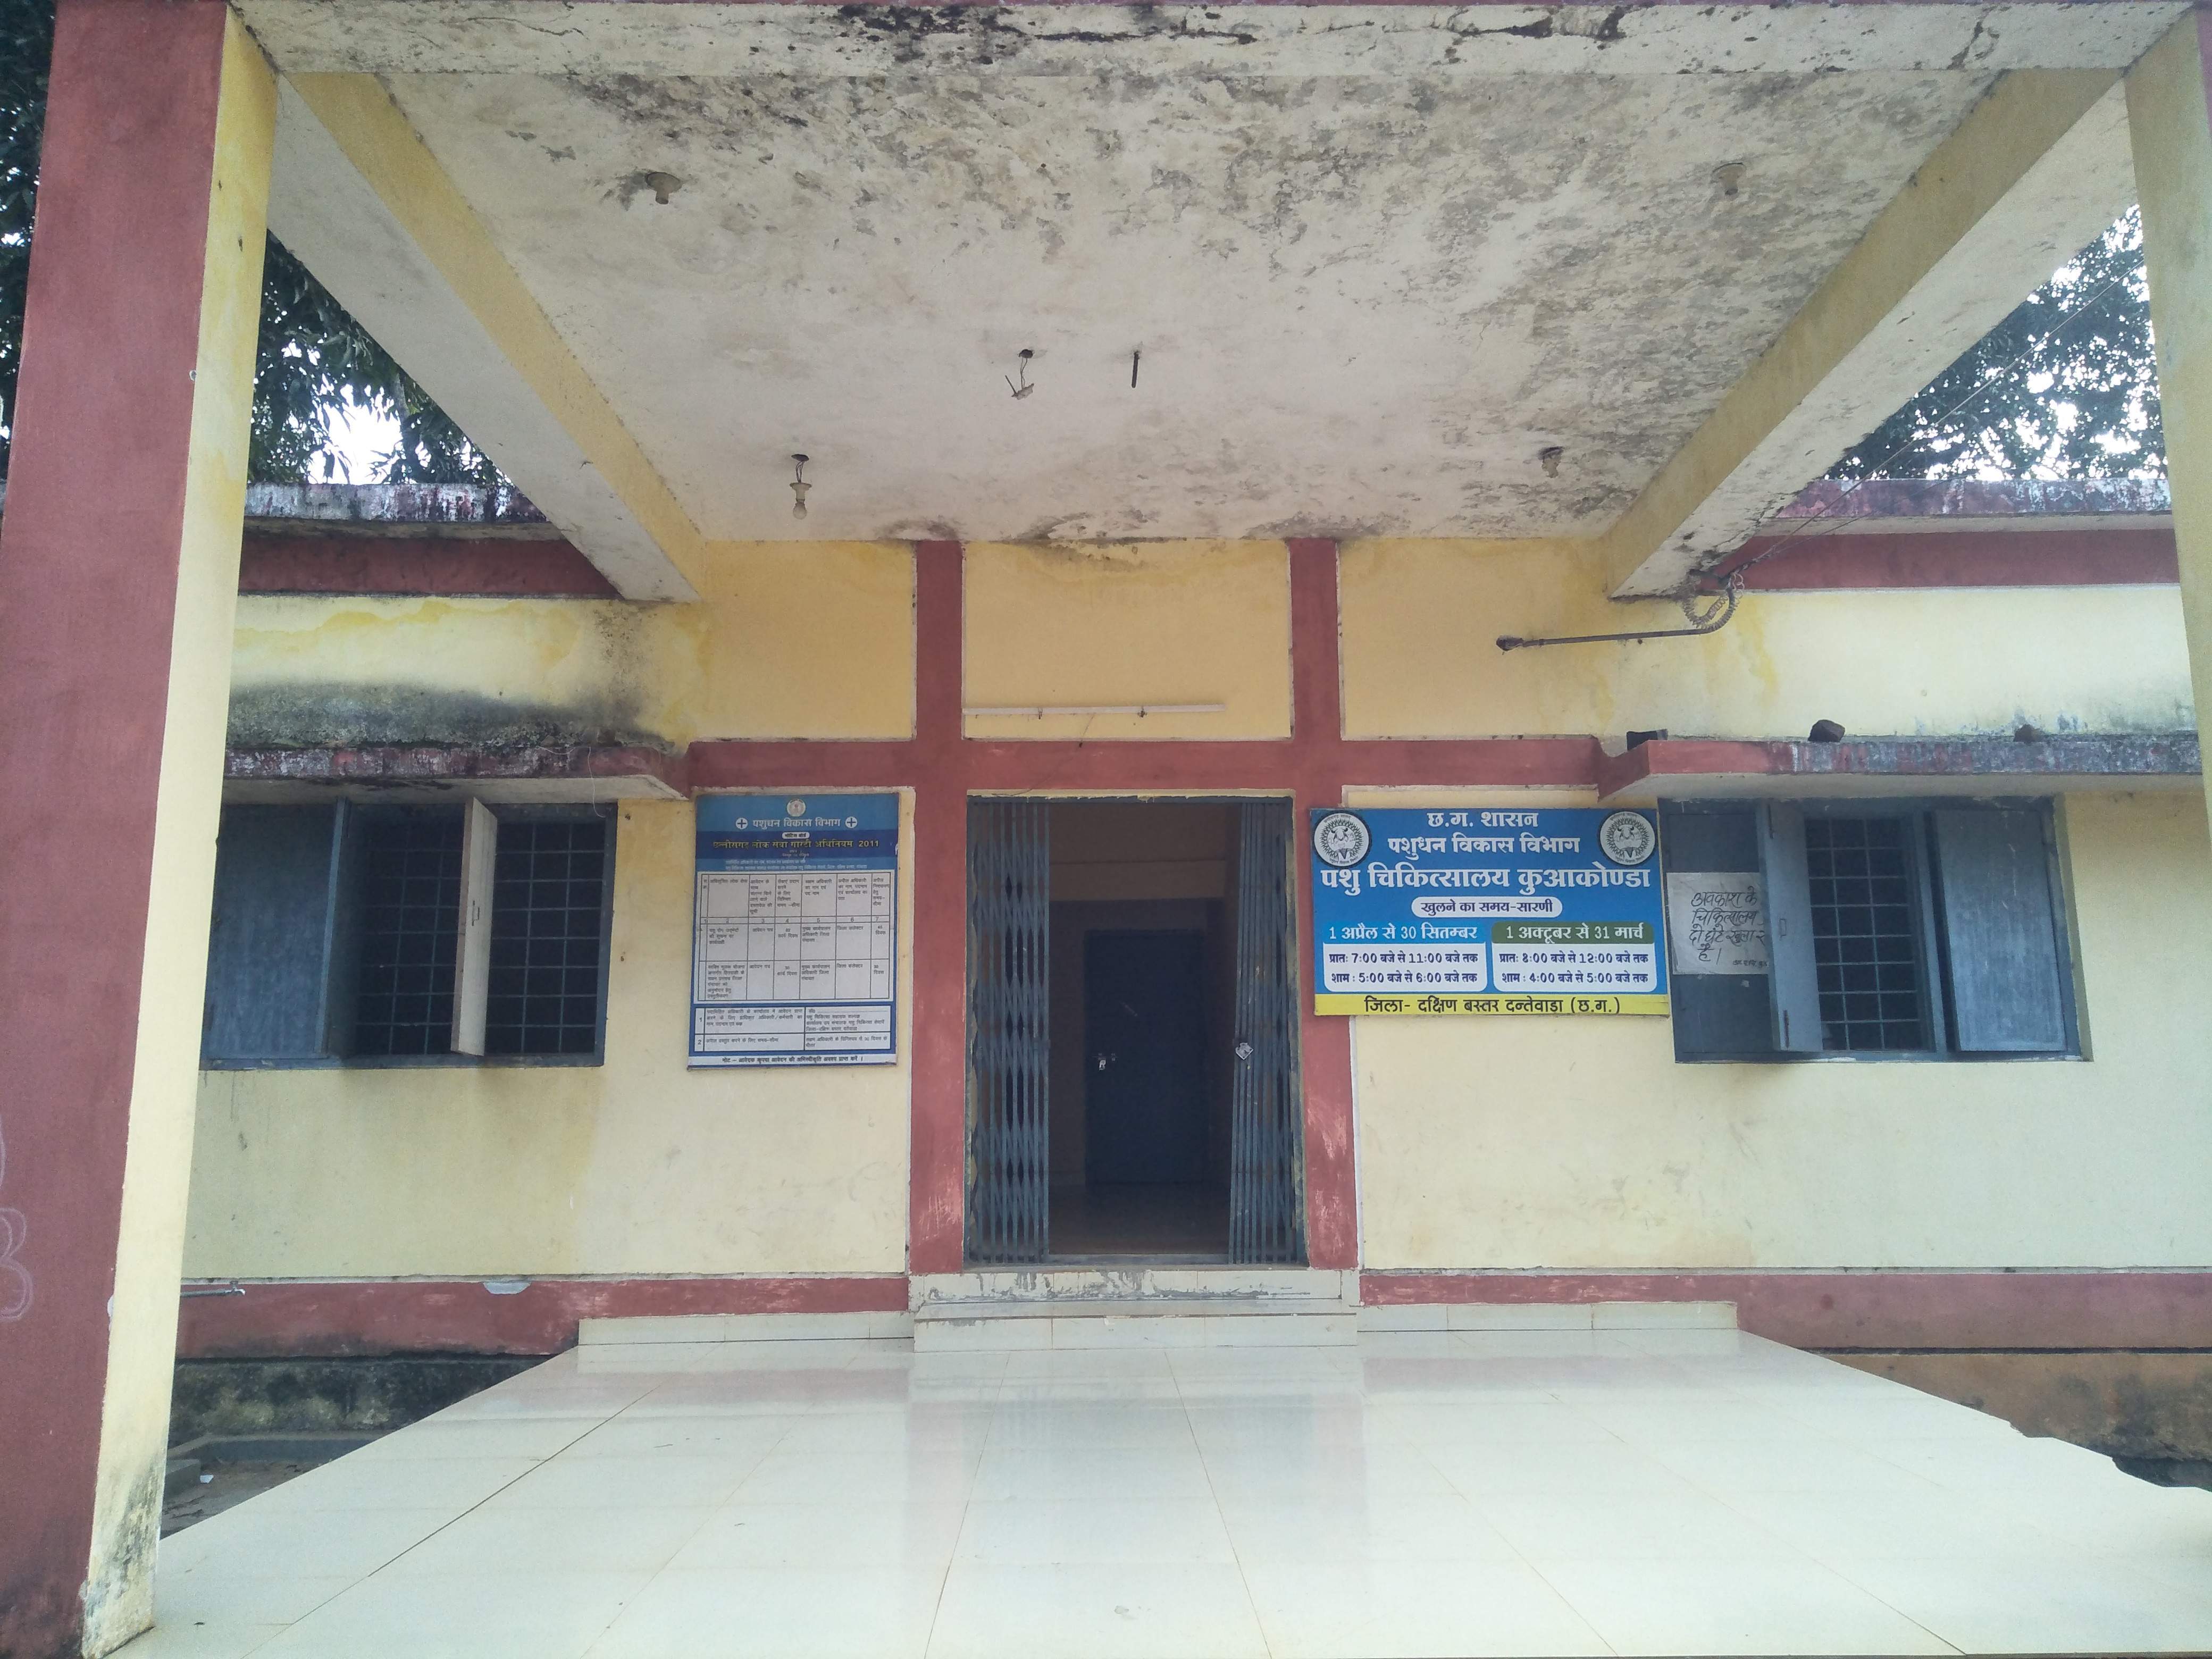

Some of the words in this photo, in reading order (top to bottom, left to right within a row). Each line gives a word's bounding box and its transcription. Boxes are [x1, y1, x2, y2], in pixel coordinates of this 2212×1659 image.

[753, 819, 780, 830] पशुधन
[784, 817, 812, 827] विकास
[815, 817, 841, 826] विभाग
[1427, 812, 1473, 827] छ.ग.
[1480, 812, 1538, 827] शासन
[752, 840, 770, 848] लोक
[816, 838, 853, 848] अधिनियम
[1387, 836, 1447, 860] पशुधन
[1452, 832, 1514, 853] विकास
[1519, 832, 1580, 853] विभाग
[1320, 869, 1361, 896] पशु
[1367, 861, 1510, 887] चिकित्सालय
[1517, 861, 1650, 895] कुआकोण्डा
[1691, 891, 1745, 908] अवकाश
[1745, 886, 1757, 906] के
[1421, 899, 1455, 916] खुलने
[1460, 902, 1475, 912] का
[1479, 899, 1553, 912] समय-सारणी
[1691, 908, 1759, 926] चिकित्सालय
[1329, 927, 1336, 939] 1
[1341, 922, 1378, 940] अप्रैल
[1382, 923, 1396, 939] से
[1401, 926, 1416, 939] 30
[1421, 921, 1478, 939] सितम्बर
[1506, 926, 1514, 939] 1
[1518, 926, 1571, 943] अक्टूबर
[1575, 923, 1589, 939] से
[1594, 926, 1610, 939] 31
[1614, 922, 1644, 939] मार्च
[1689, 924, 1704, 945] दो
[1705, 924, 1724, 944] घंटे
[1727, 930, 1754, 946] खुला
[1351, 953, 1377, 963] 7:00
[1380, 950, 1395, 963] बजे
[1397, 950, 1406, 963] से
[1408, 953, 1442, 963] 11:00
[1445, 950, 1460, 963] बजे
[1462, 953, 1478, 963] तक
[1522, 953, 1547, 963] 8:00
[1551, 950, 1566, 963] बजे
[1568, 950, 1577, 963] से
[1579, 953, 1613, 963] 12:00
[1615, 950, 1631, 963] बजे
[1633, 953, 1649, 963] तक
[1331, 973, 1350, 983] शाम
[1359, 973, 1384, 983] 5:00
[1387, 970, 1402, 983] बजे
[1404, 970, 1413, 983] से
[1416, 973, 1442, 983] 6:00
[1445, 970, 1460, 983] बजे
[1462, 973, 1478, 983] तक
[1502, 973, 1520, 983] शाम
[1529, 973, 1555, 983] 4:00
[1557, 970, 1573, 983] बजे
[1575, 970, 1583, 983] से
[1587, 973, 1612, 983] 5:00
[1615, 970, 1630, 983] बजे
[1632, 973, 1648, 983] तक
[1364, 995, 1410, 1012] जिला-
[1417, 995, 1457, 1013] दक्षिण
[1463, 1000, 1499, 1012] बस्तर
[1571, 997, 1620, 1013] (छ.ग.)
